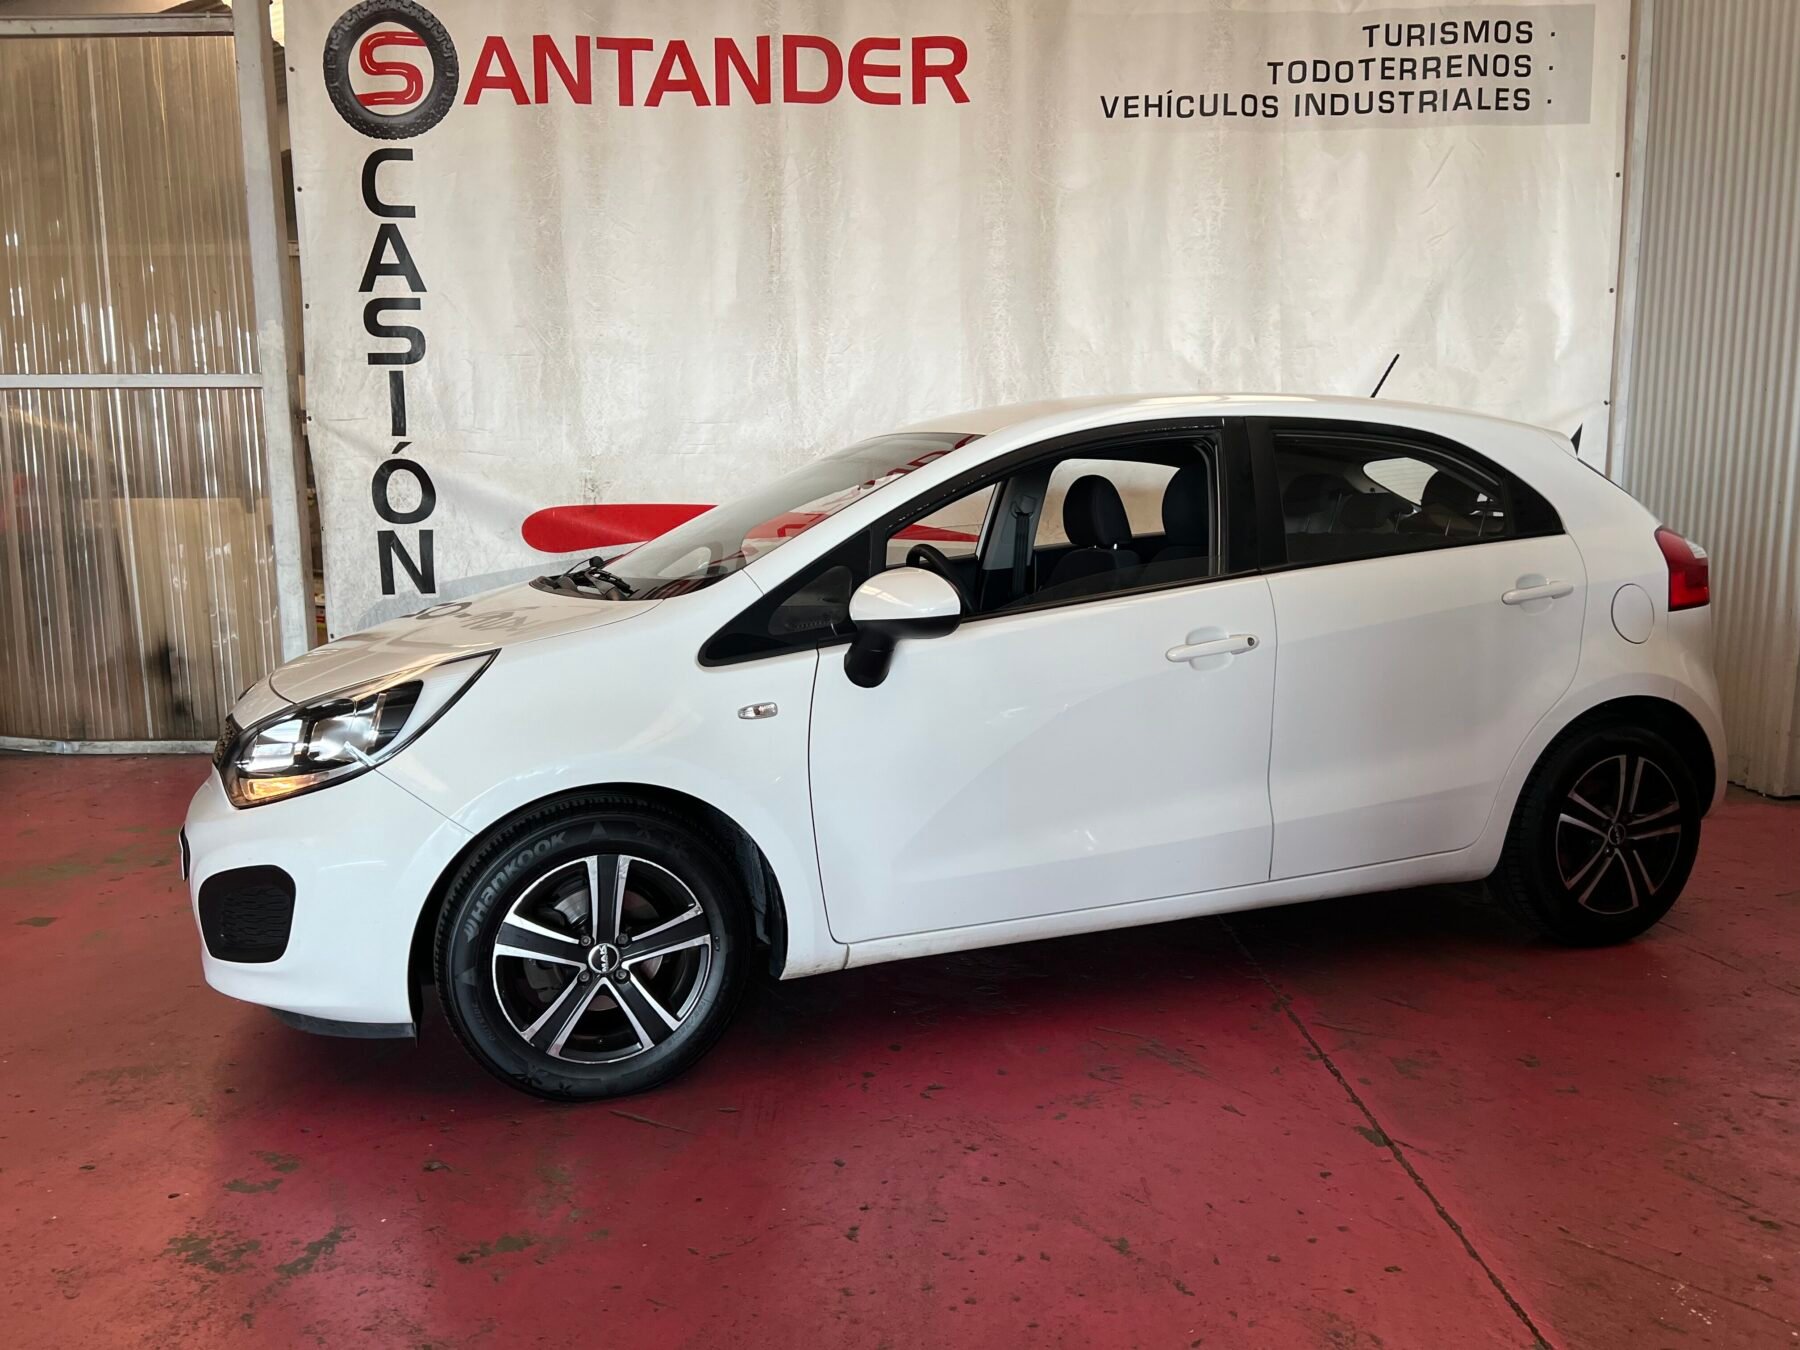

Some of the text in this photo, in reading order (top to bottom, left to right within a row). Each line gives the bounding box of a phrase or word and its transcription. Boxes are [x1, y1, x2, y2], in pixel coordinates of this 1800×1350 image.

[1363, 20, 1533, 48] TURISMOS
[358, 31, 970, 107] SANTANDER
[1267, 54, 1532, 85] TODOTERRENOS
[1101, 87, 1531, 119] VEHÍCULOS INDUSTRIALES
